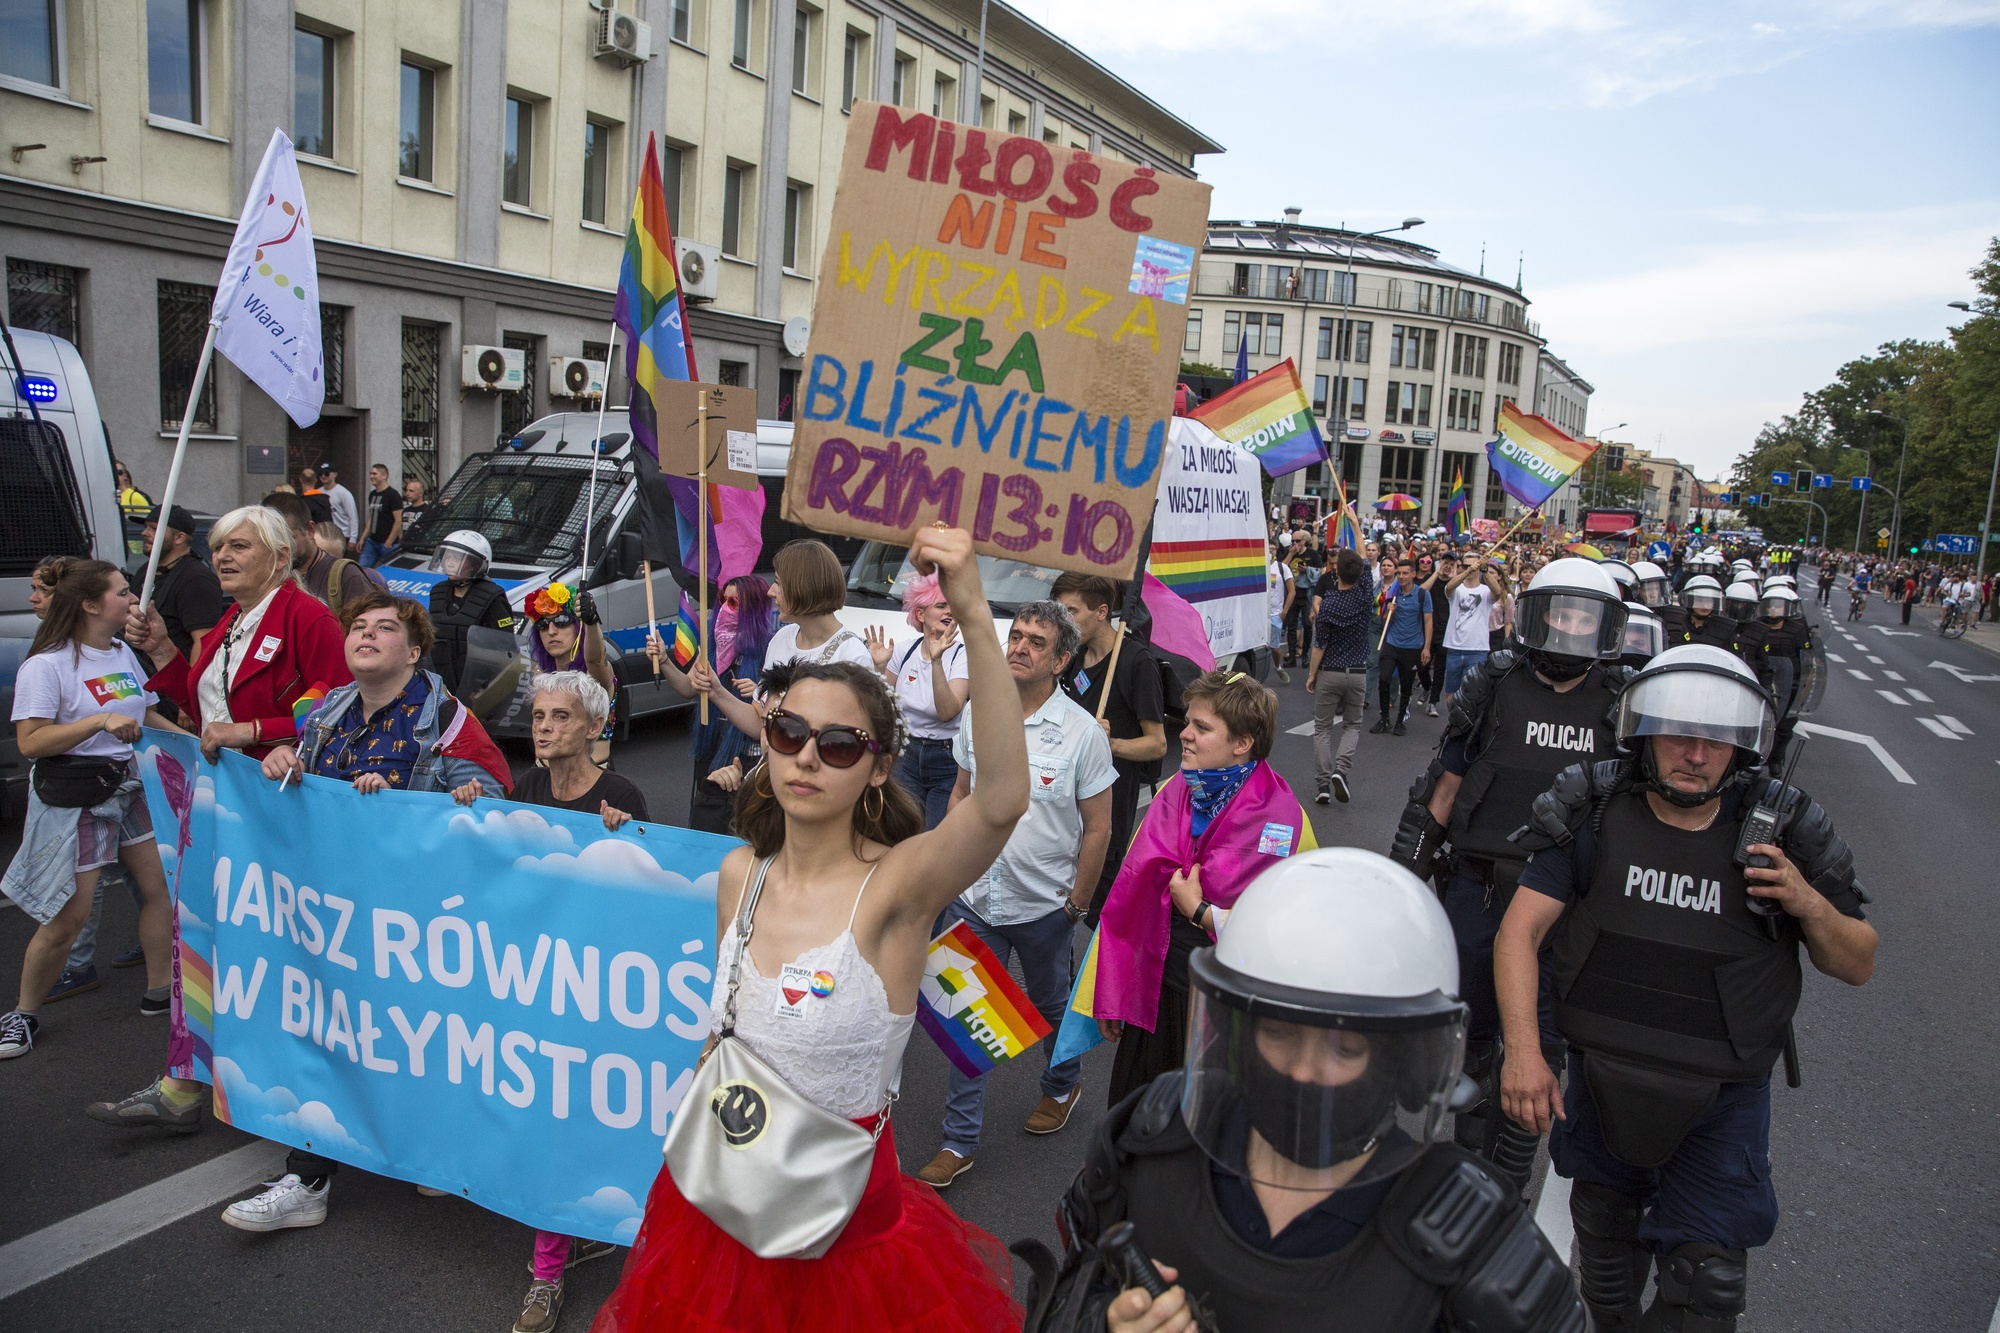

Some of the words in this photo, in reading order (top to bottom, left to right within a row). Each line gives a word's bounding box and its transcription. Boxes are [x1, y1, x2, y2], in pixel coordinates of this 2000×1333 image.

[243, 293, 285, 338] Wiara
[836, 229, 1161, 355] WYRZĄDZA
[900, 312, 1046, 393] ZŁA
[1181, 444, 1198, 472] ZA
[972, 472, 1135, 566] 13:10
[1168, 485, 1210, 520] WASZĄ
[498, 645, 532, 727] POLICJA
[1525, 721, 1595, 753] POLICJA
[1412, 830, 1426, 860] POLICJA
[1624, 864, 1722, 915] POLICJA
[212, 944, 269, 1020] W
[784, 966, 812, 977] STREFA
[964, 1006, 1009, 1059] kph
